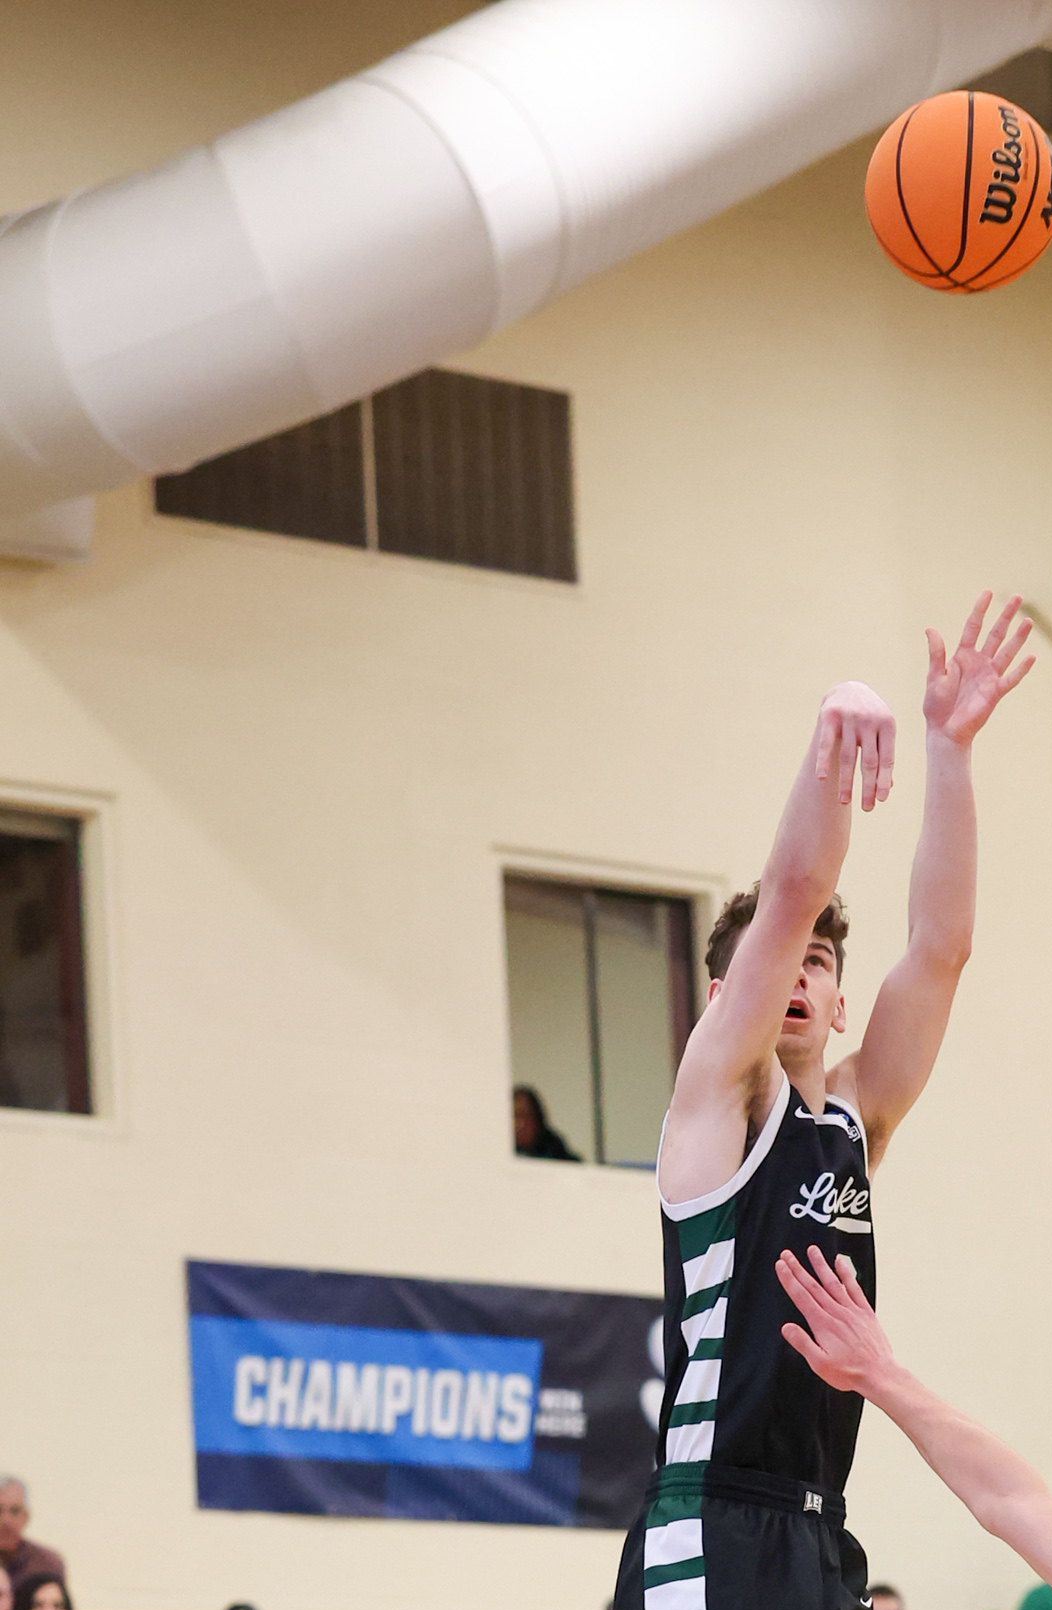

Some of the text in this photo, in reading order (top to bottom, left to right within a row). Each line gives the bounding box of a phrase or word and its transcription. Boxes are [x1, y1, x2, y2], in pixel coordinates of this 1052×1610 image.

[979, 105, 1022, 226] Wilson
[789, 1171, 869, 1224] Lake
[233, 1354, 533, 1444] CHAMPIONS
